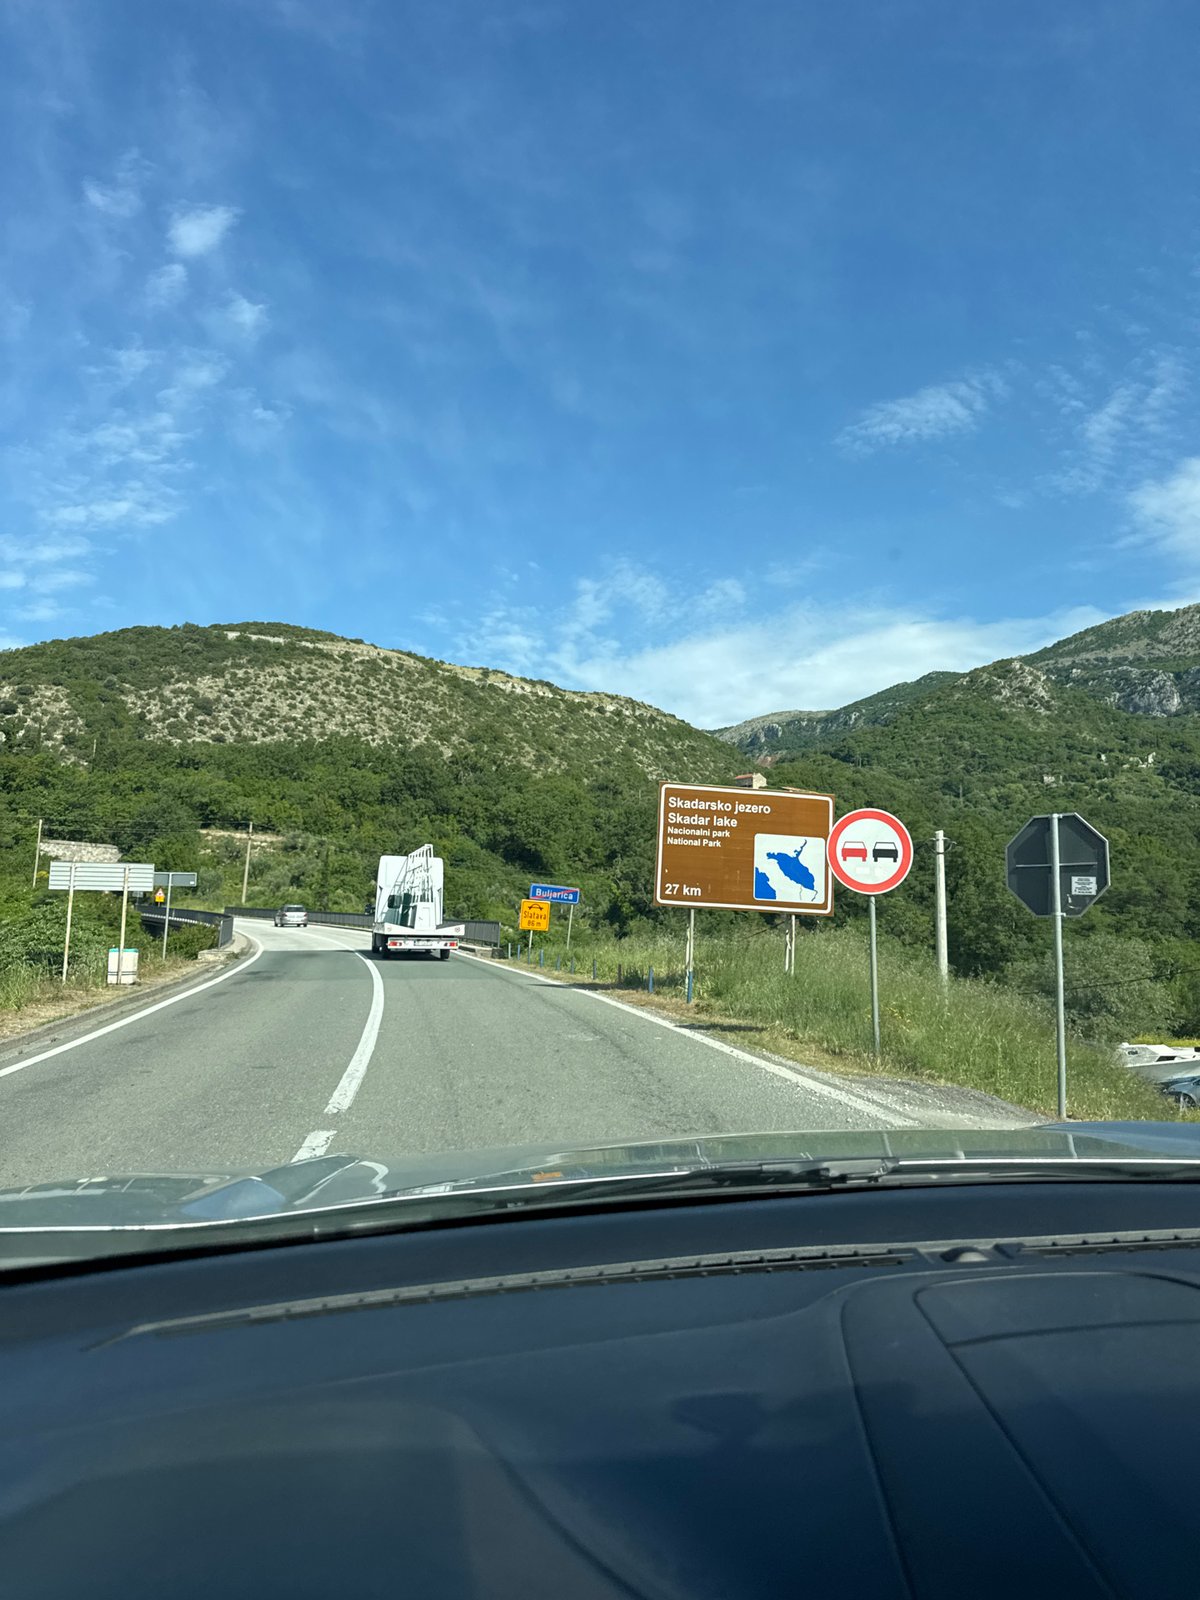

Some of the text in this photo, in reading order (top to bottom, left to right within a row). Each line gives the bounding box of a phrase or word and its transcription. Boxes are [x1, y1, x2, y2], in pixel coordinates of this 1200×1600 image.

[668, 797, 771, 814] Skadarsko jezero
[668, 812, 738, 827] Skadar lake
[667, 826, 730, 838] Nacionalni park
[667, 837, 721, 847] National Park
[535, 888, 573, 900] Buljarica
[665, 883, 702, 896] 27 km
